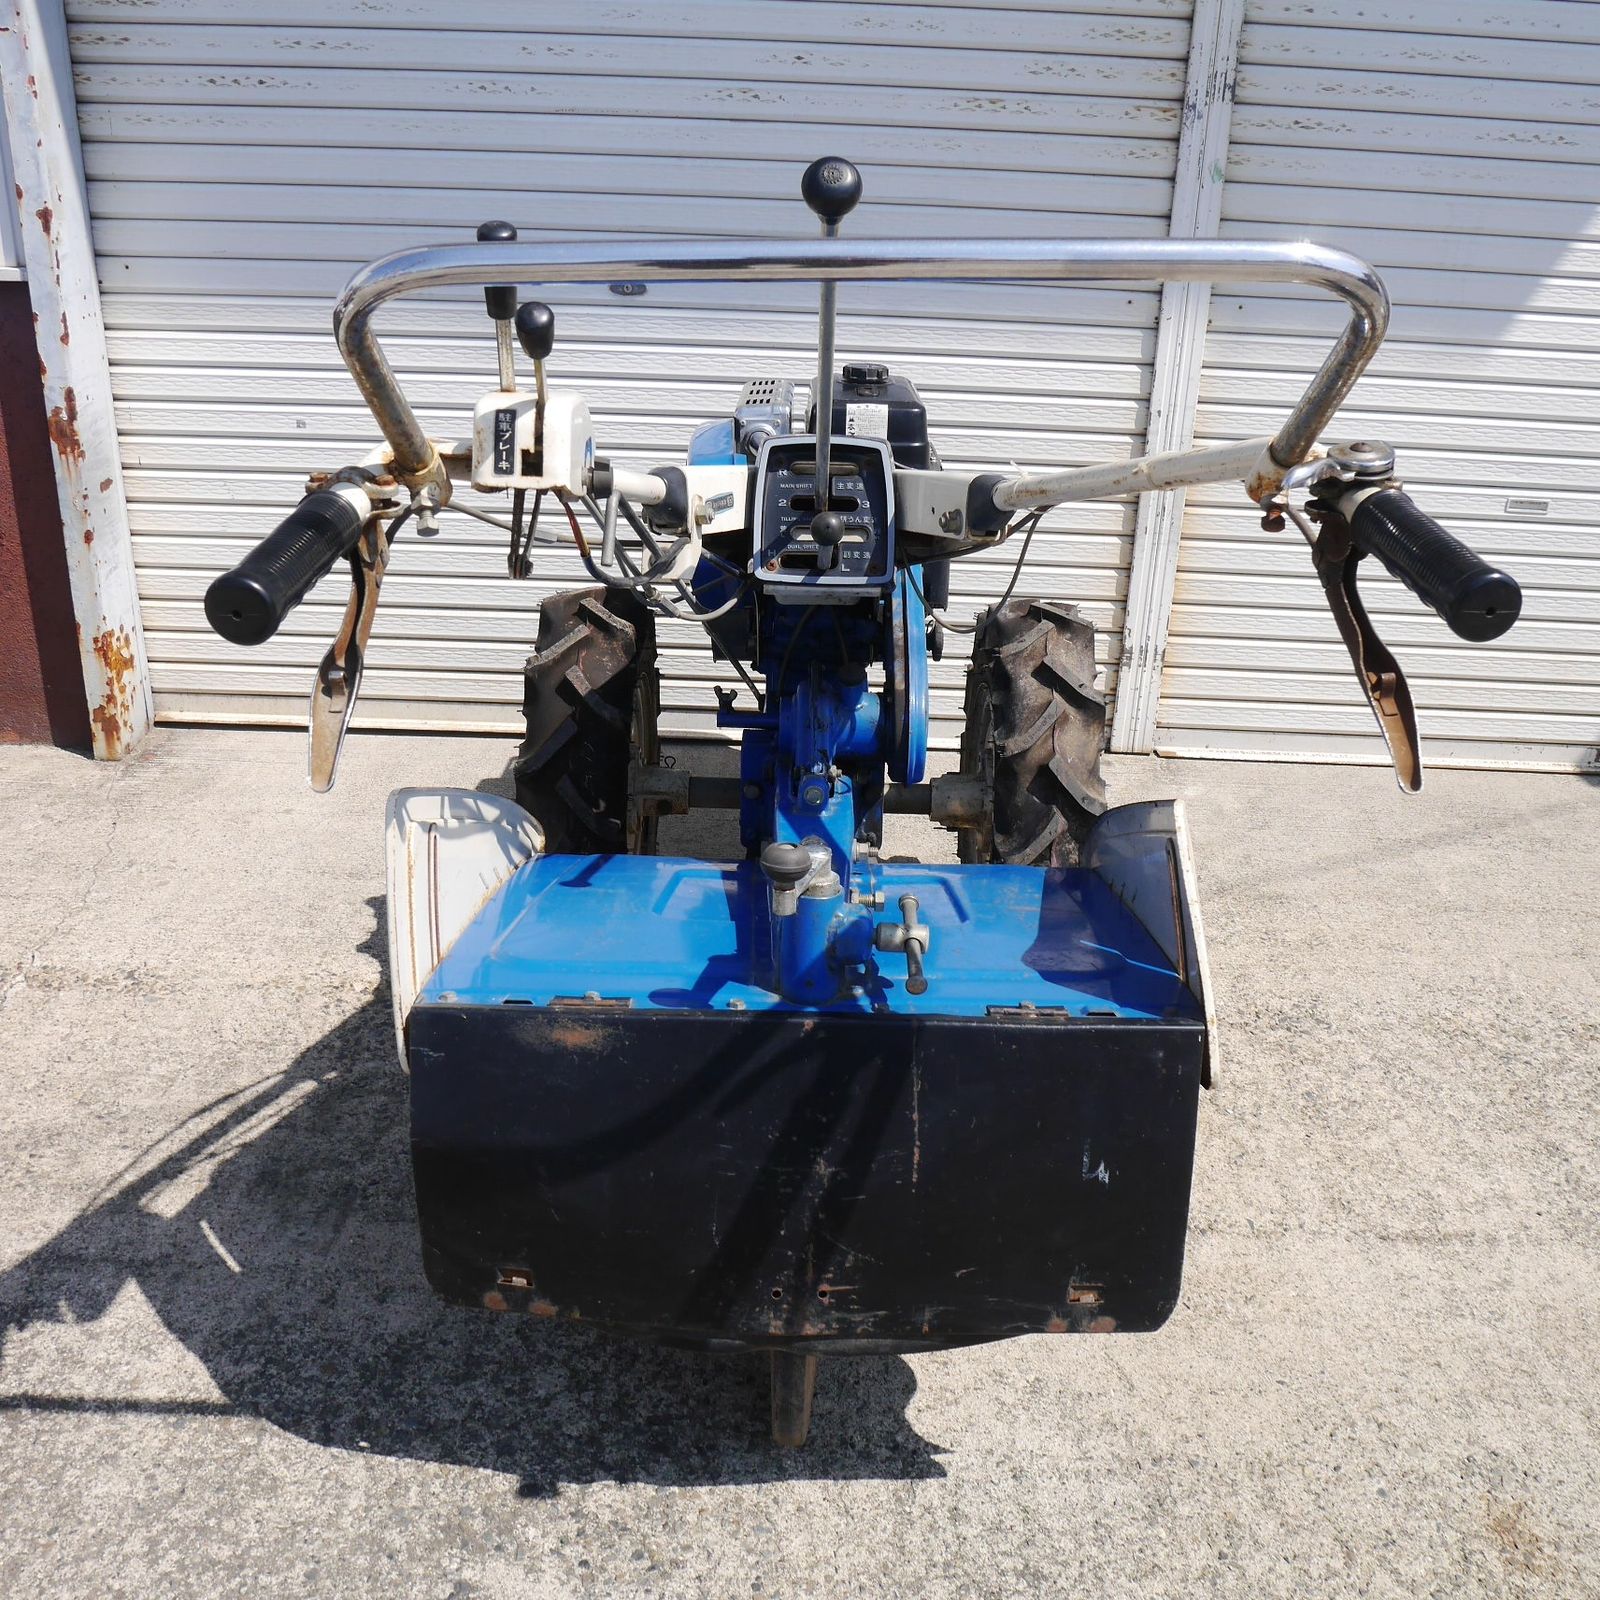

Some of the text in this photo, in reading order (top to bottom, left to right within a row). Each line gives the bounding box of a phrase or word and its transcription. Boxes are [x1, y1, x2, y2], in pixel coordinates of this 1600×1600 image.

[498, 412, 512, 470] 駐車ブレーキ
[841, 564, 850, 572] L
